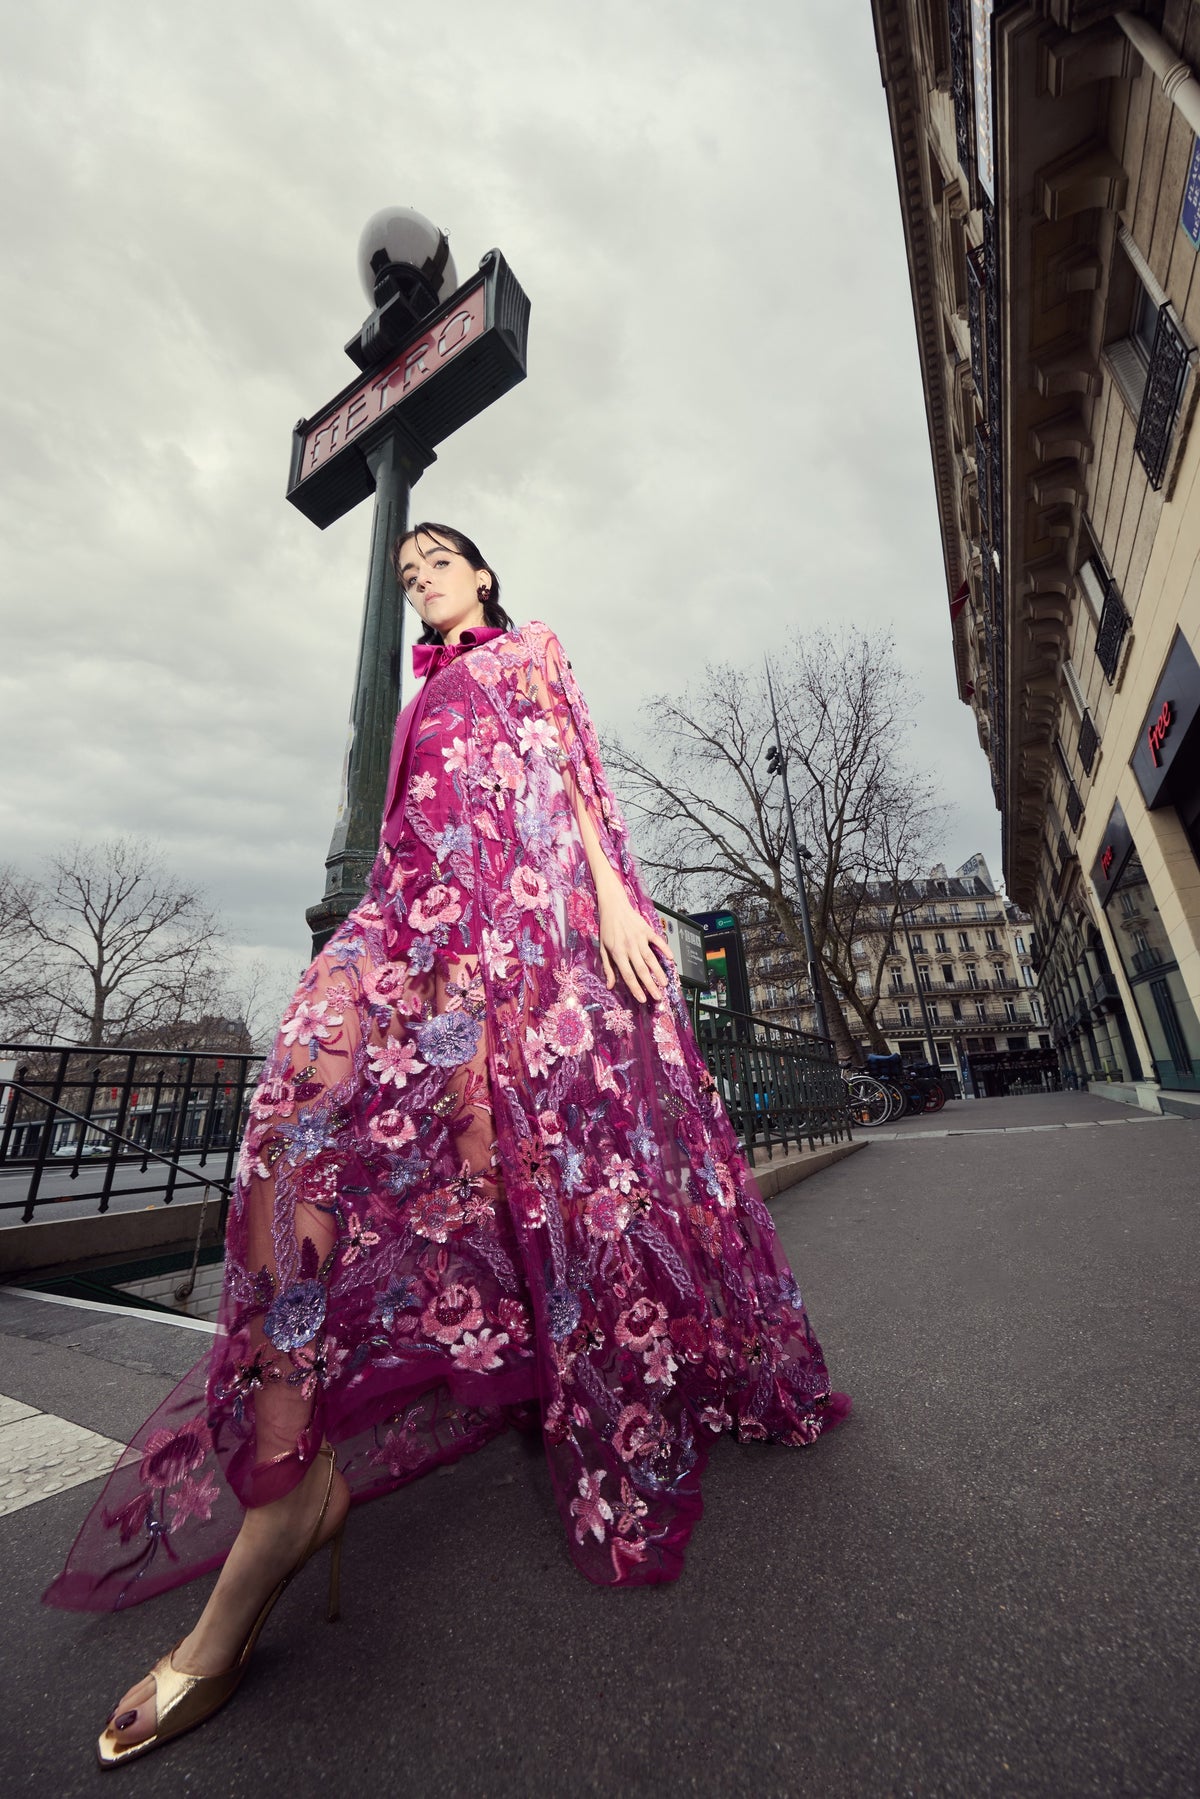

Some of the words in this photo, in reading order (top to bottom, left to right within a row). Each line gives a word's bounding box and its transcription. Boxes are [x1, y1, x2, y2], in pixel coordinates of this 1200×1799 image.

[310, 310, 475, 468] METRO
[1148, 701, 1171, 768] free
[1101, 845, 1112, 881] free
